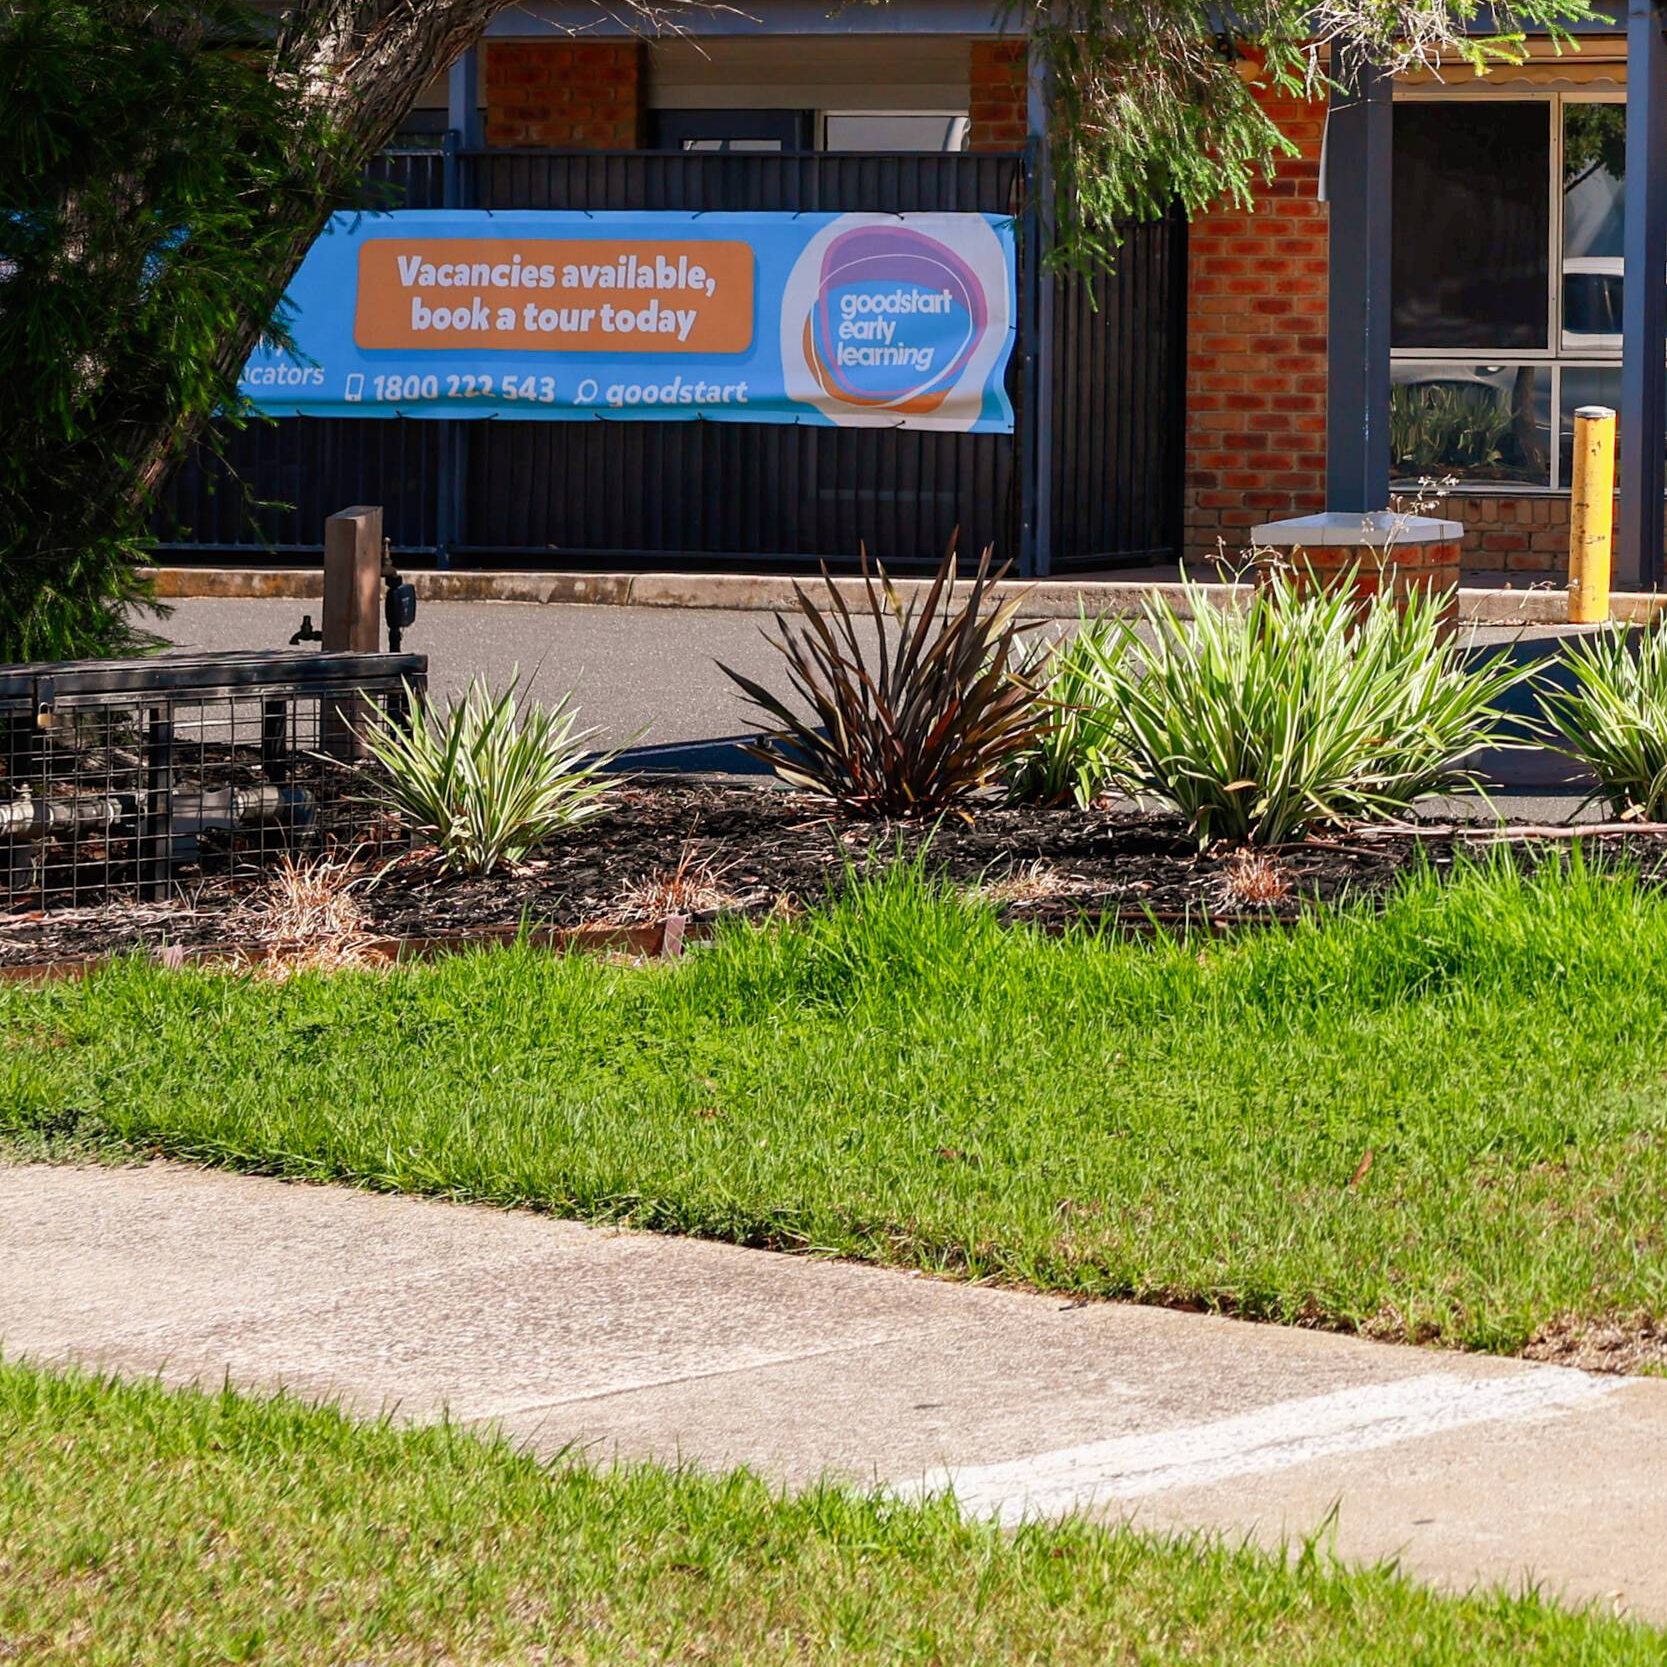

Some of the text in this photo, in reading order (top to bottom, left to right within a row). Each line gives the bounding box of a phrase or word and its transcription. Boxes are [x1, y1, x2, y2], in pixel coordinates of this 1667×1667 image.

[397, 254, 716, 297] Vacancies available,
[411, 296, 697, 342] book a tour today
[840, 288, 952, 320] goodstart
[838, 315, 896, 345] early
[837, 341, 935, 372] learning
[373, 374, 748, 407] 1800 222 543 goodstart
